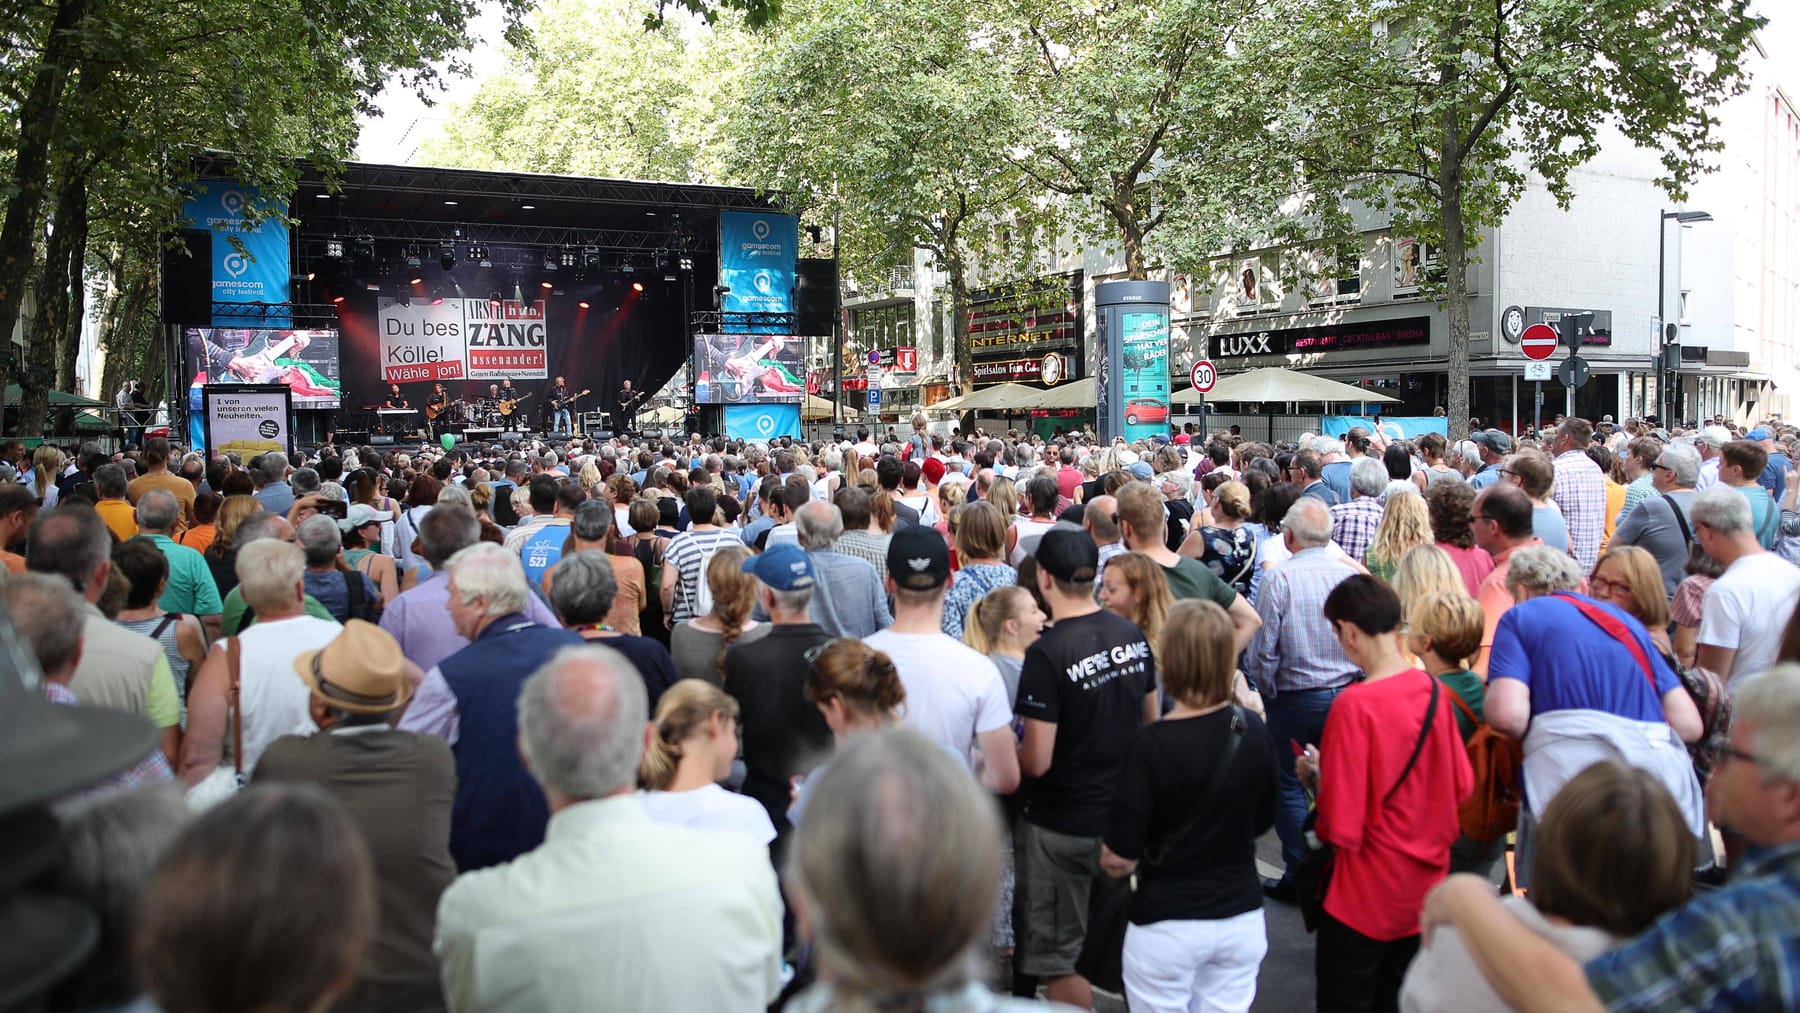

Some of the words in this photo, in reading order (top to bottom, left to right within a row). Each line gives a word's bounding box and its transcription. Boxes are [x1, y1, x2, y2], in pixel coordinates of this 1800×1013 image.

[741, 242, 782, 250] gamescom
[222, 288, 237, 296] city
[238, 288, 264, 296] festival
[387, 319, 415, 336] Du
[423, 318, 460, 336] bes
[469, 323, 545, 347] ZÄNG
[1396, 329, 1424, 338] SHISHA
[1137, 341, 1153, 351] HAT
[1220, 334, 1272, 356] LUXX
[388, 346, 445, 363] Kölle!
[472, 353, 543, 365] ussenander!
[388, 367, 431, 381] Wähle
[436, 363, 461, 379] jon!
[1196, 369, 1211, 384] 30
[870, 390, 878, 402] P
[528, 556, 548, 568] 523
